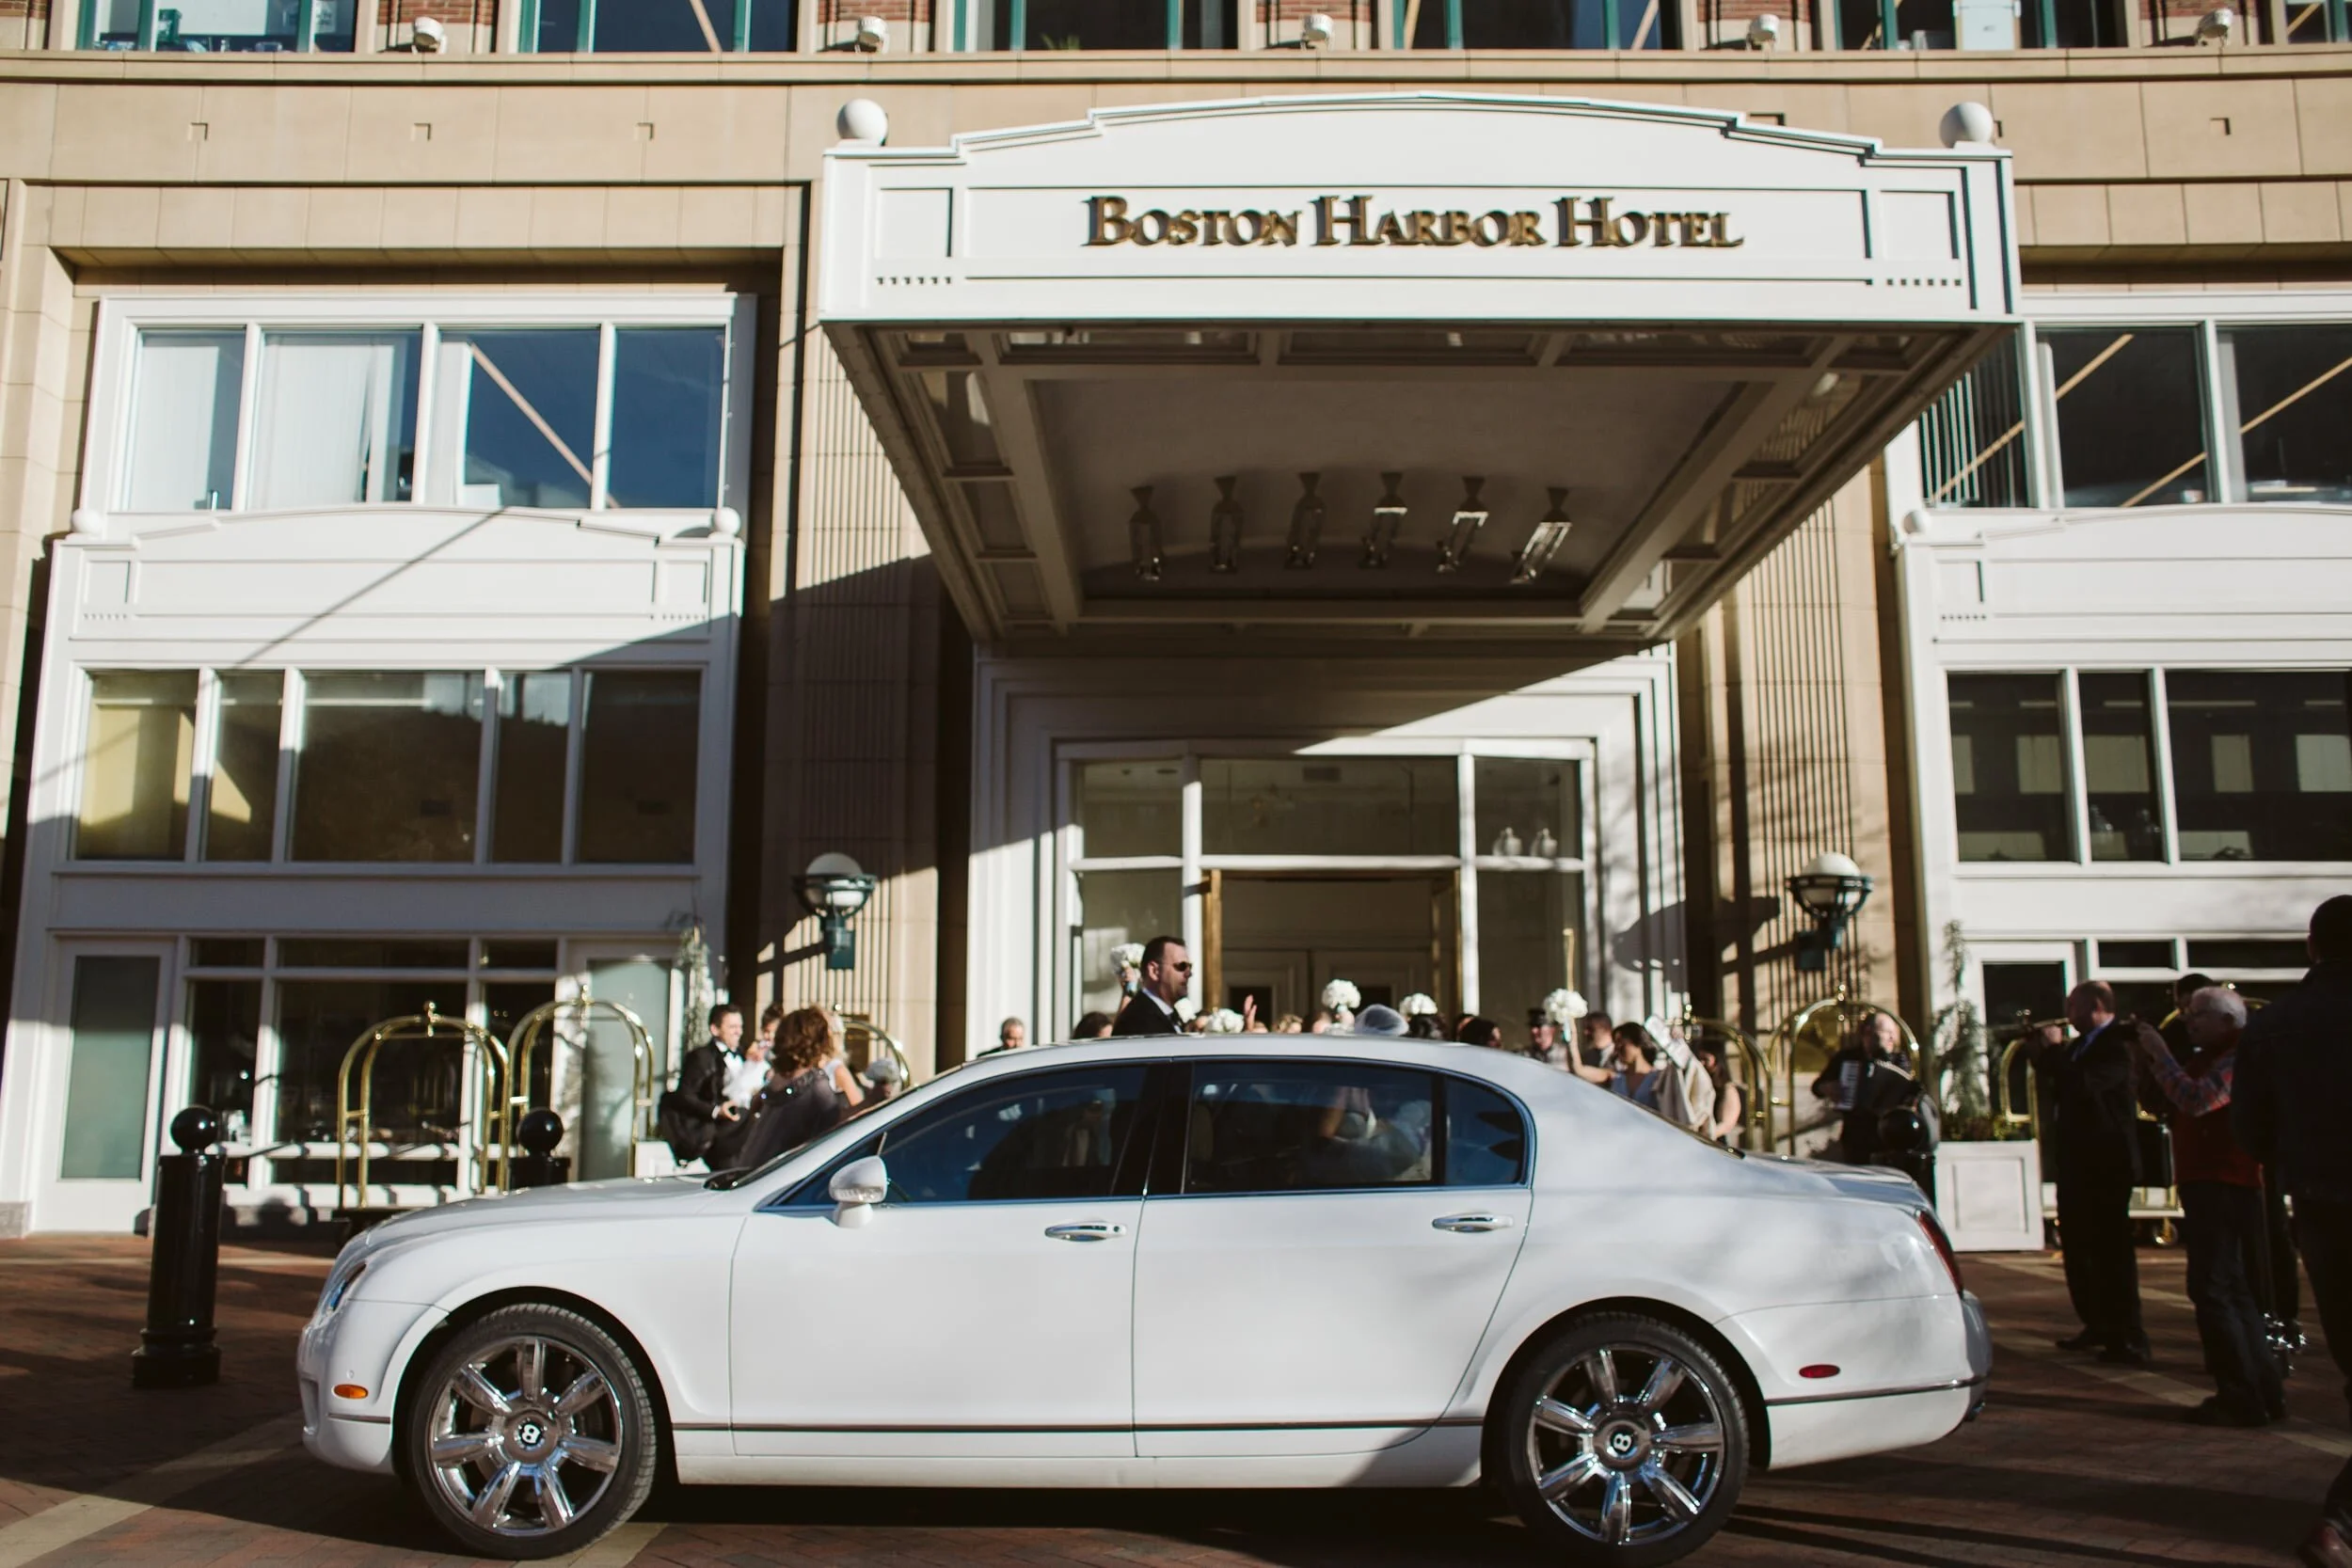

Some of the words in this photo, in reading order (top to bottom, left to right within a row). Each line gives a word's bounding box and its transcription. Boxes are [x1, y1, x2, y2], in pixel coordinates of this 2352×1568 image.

[1080, 195, 1302, 246] BOSTON
[1308, 195, 1547, 247] HARBOR
[1550, 196, 1744, 247] HOTEL
[521, 1423, 541, 1444] B
[1613, 1433, 1632, 1452] B
